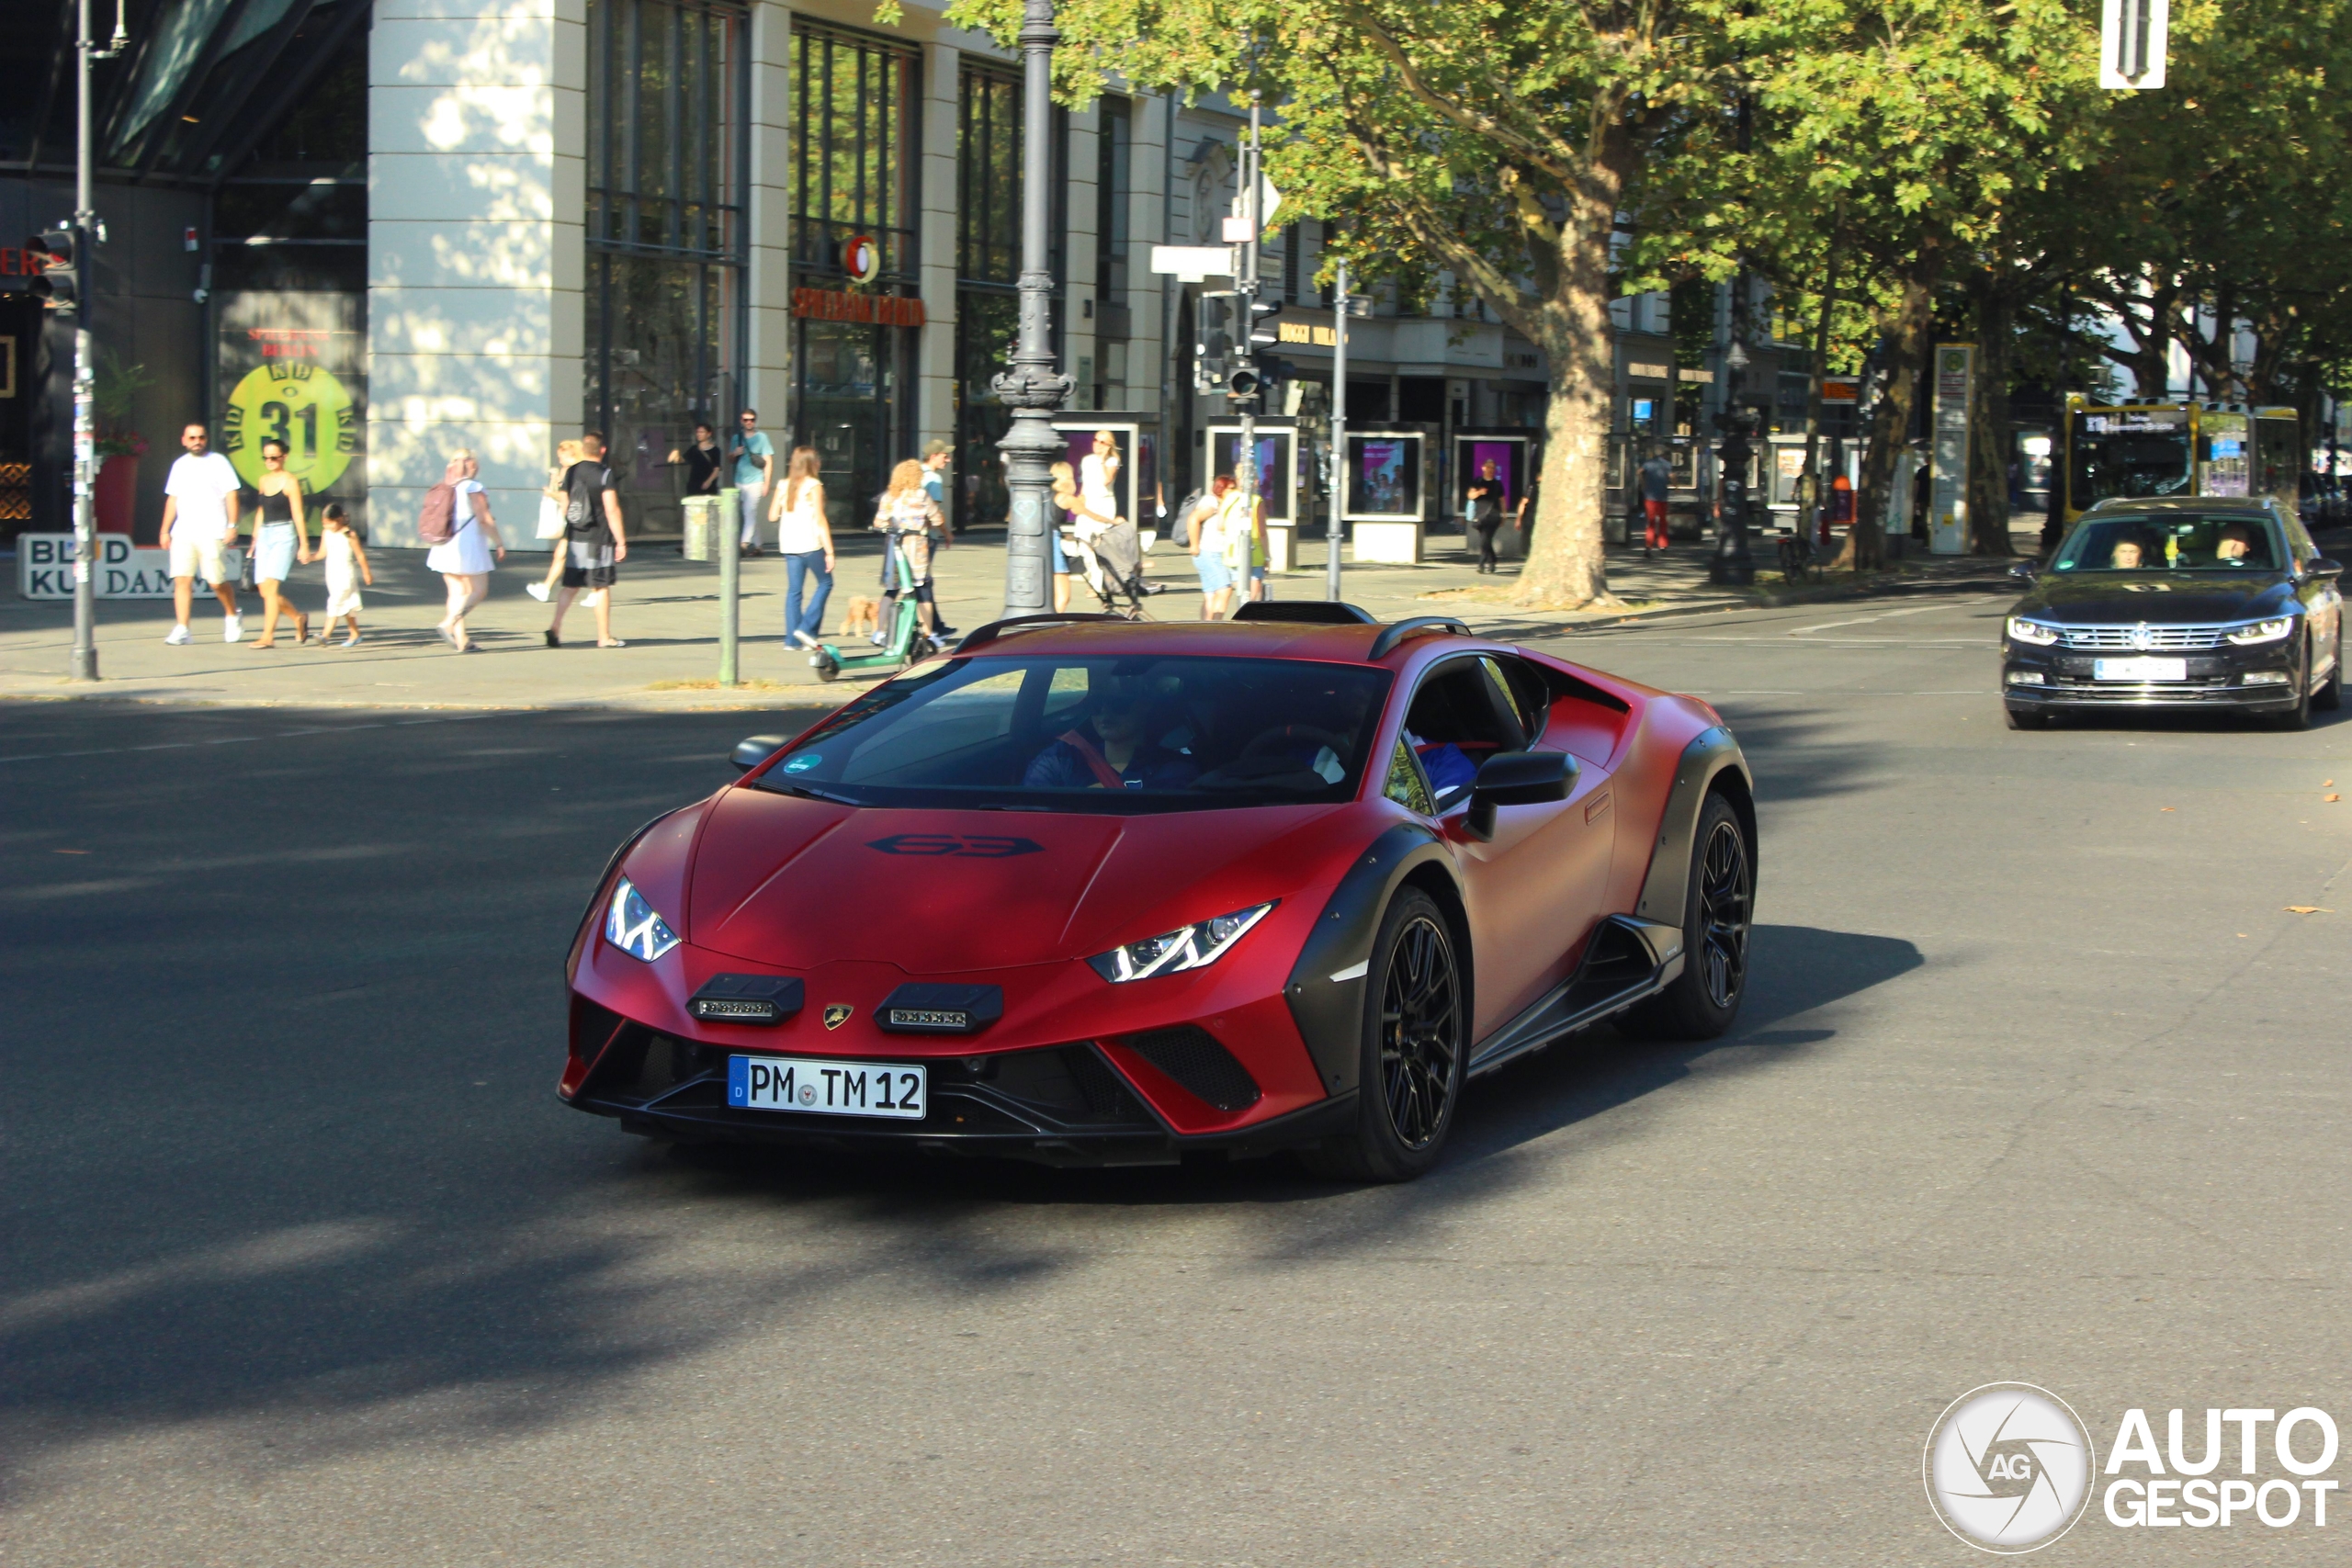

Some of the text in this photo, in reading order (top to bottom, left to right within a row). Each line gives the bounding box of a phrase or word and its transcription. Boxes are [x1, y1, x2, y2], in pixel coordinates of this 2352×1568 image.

[262, 344, 318, 357] BERLIN
[259, 400, 318, 458] 31
[864, 834, 1046, 858] 63
[735, 1087, 743, 1098] D
[751, 1064, 794, 1103] PM
